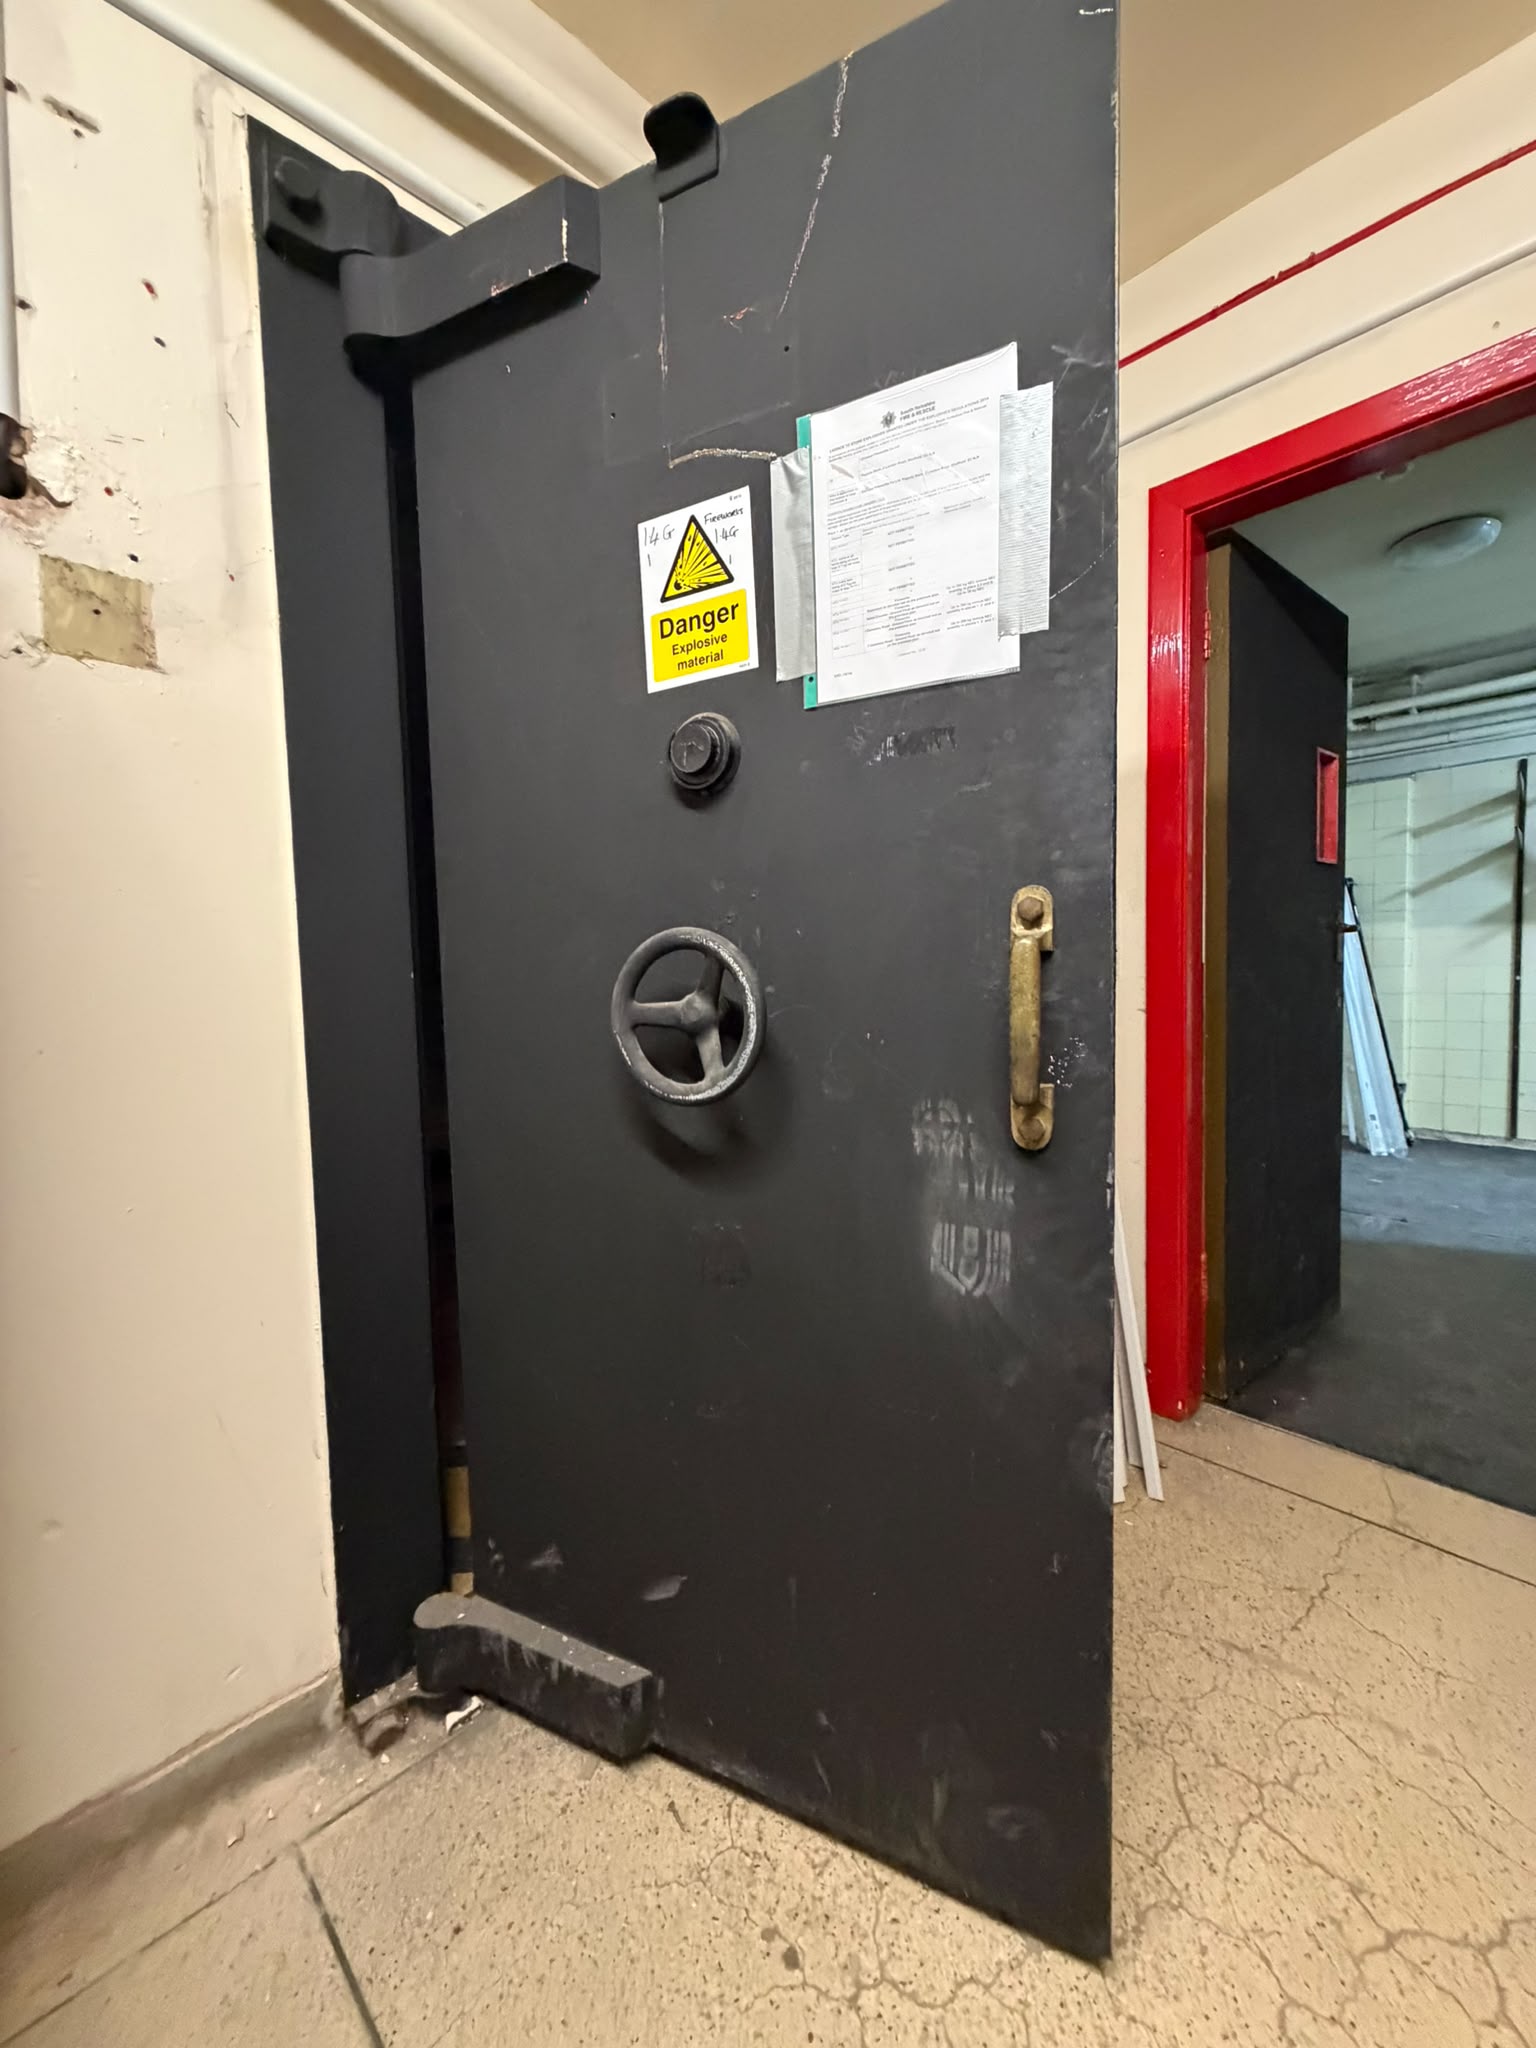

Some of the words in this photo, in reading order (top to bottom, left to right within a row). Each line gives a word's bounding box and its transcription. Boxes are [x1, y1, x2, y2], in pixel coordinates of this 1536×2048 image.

[915, 406, 936, 416] RESCUE
[659, 602, 740, 640] Danger
[672, 632, 728, 656] Explosive
[677, 649, 724, 671] material
